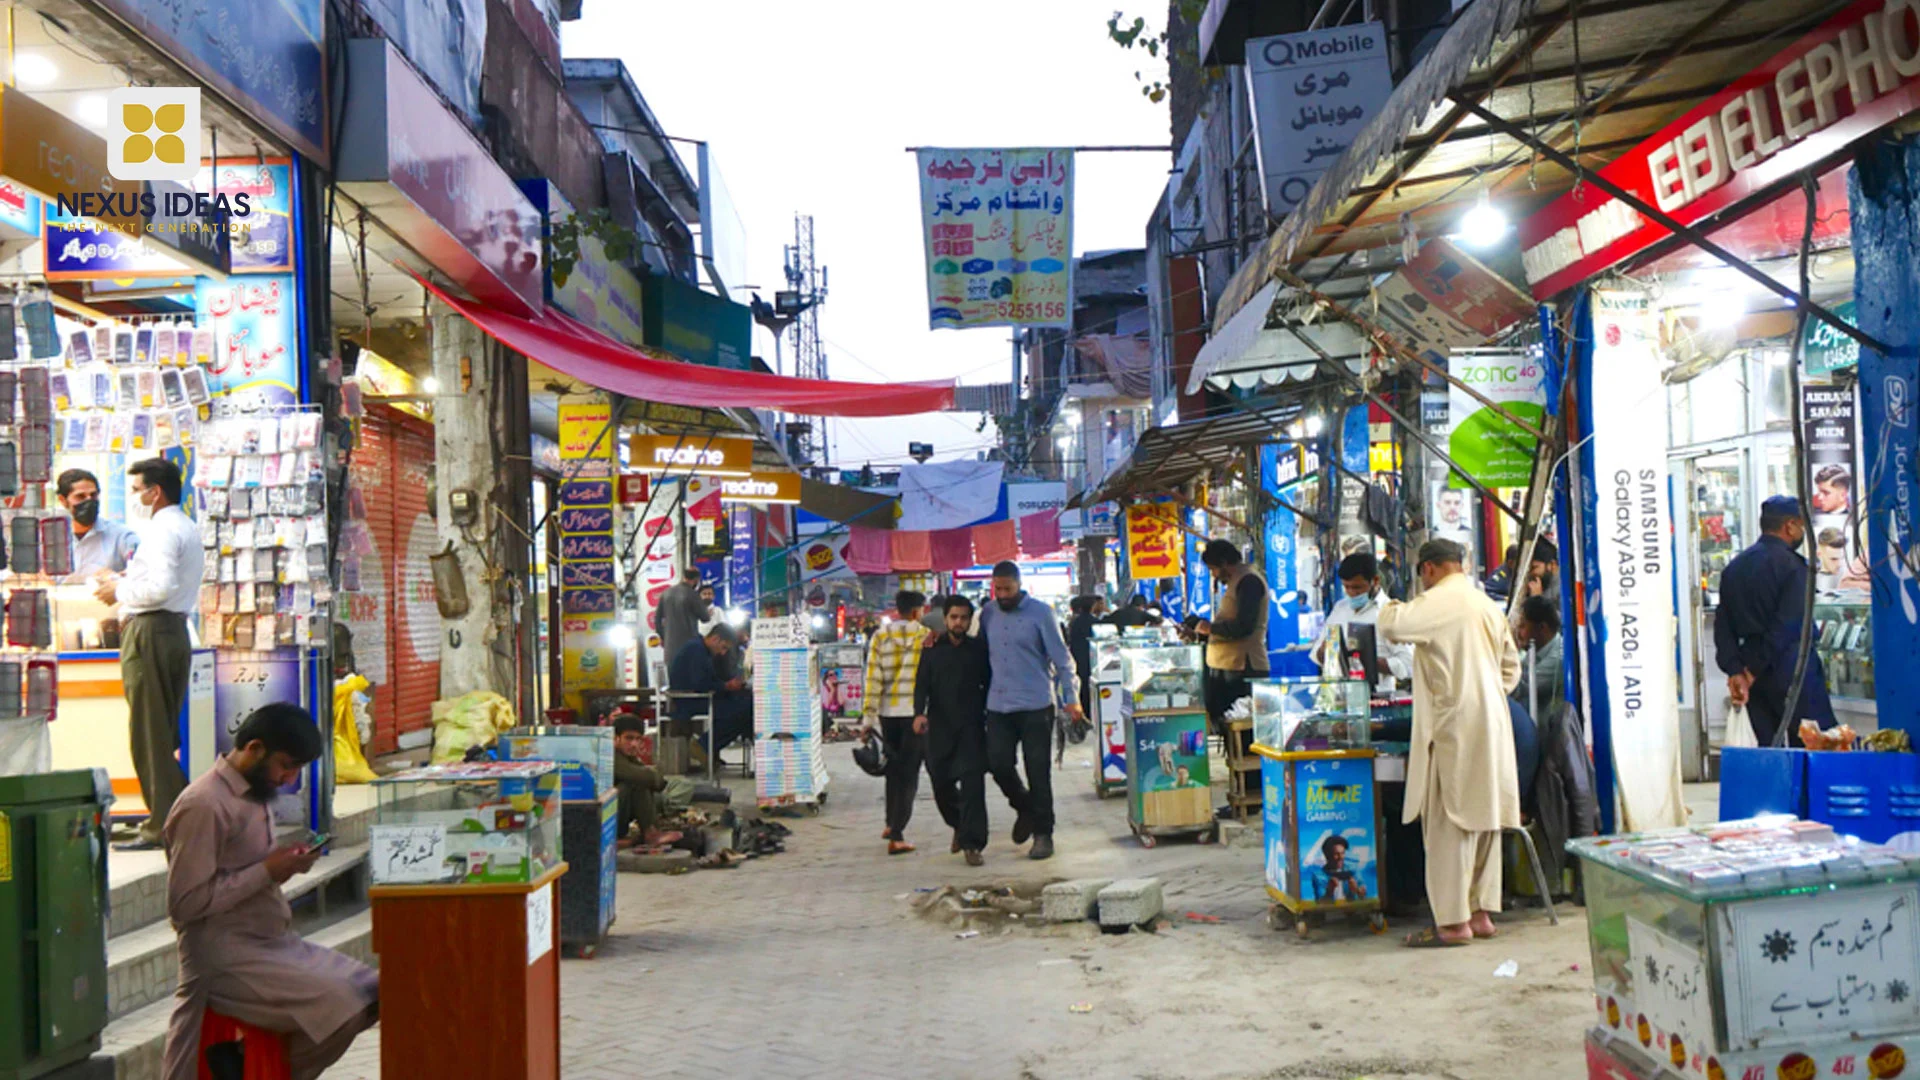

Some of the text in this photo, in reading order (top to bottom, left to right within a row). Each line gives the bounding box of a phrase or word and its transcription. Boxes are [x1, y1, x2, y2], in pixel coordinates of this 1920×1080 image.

[655, 444, 725, 466] realme
[722, 478, 779, 497] realme
[1611, 469, 1633, 548] Galaxy
[1639, 469, 1661, 576] SAMSUNG
[1617, 549, 1637, 598] A30s
[1620, 611, 1640, 661] A20s
[1623, 674, 1643, 720] A10s
[1832, 1054, 1856, 1076] 4G
